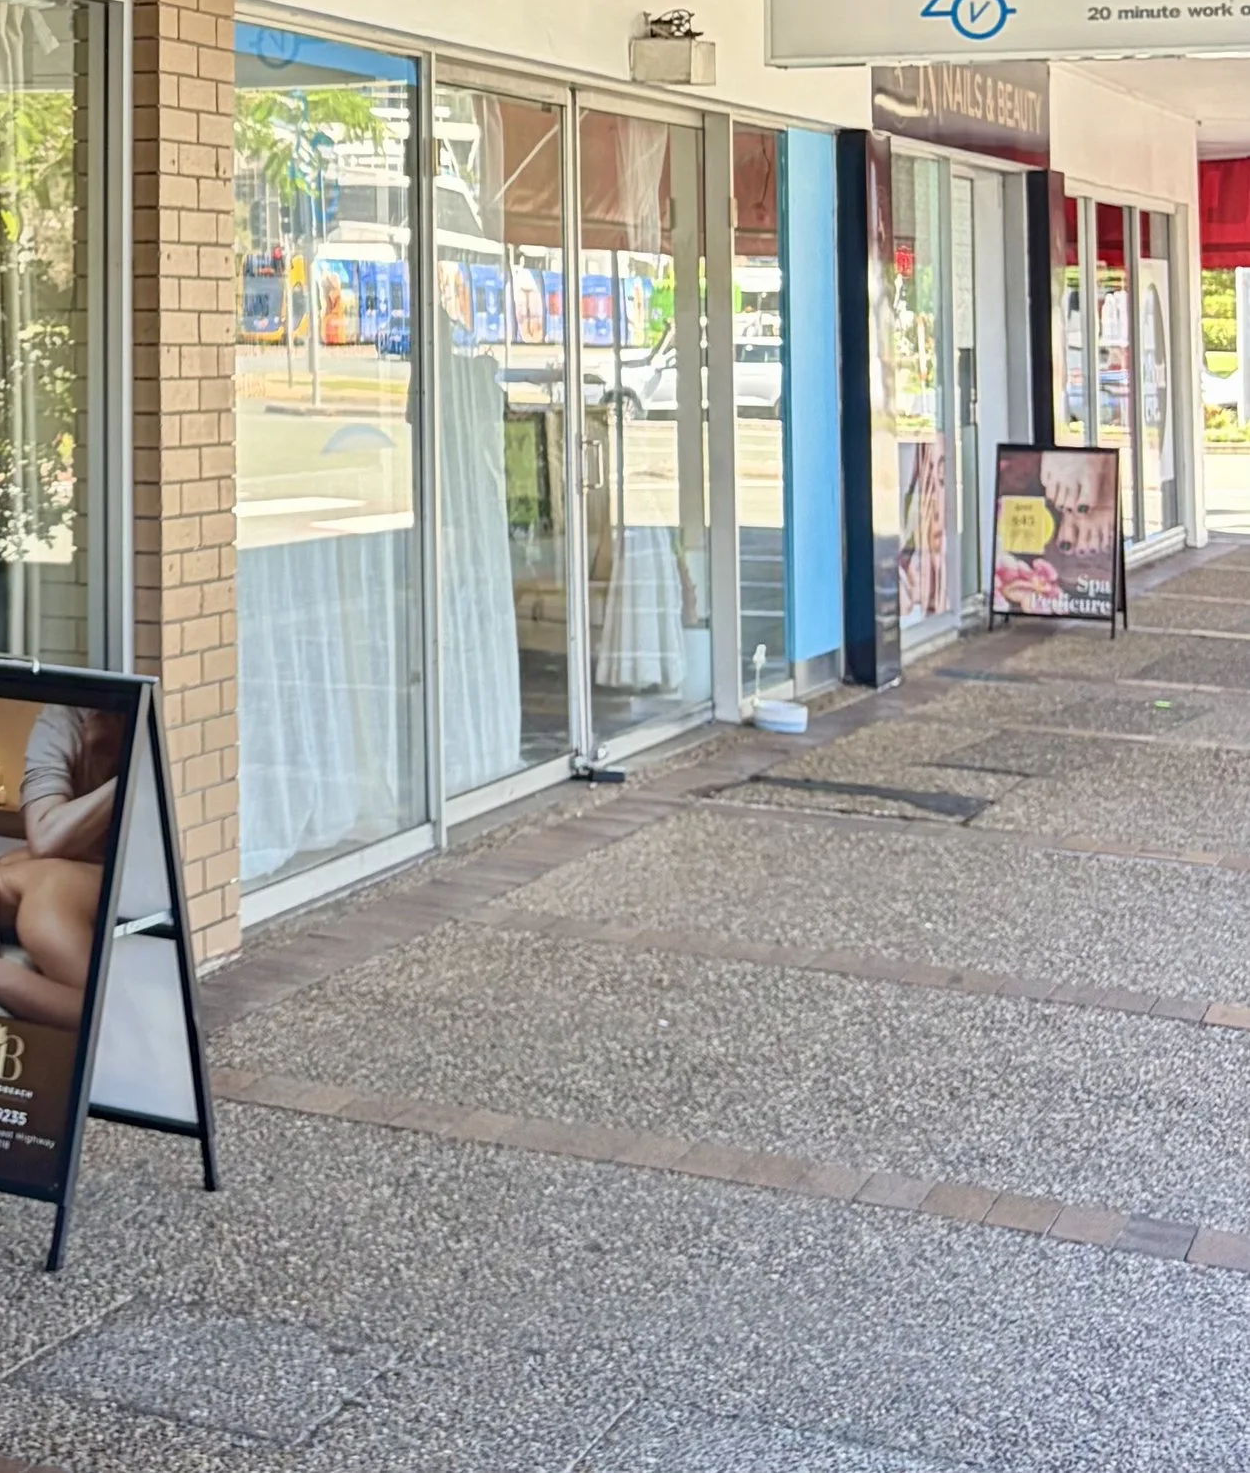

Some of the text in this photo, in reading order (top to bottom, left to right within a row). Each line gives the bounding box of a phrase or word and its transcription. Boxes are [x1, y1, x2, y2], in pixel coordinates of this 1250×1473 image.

[1087, 6, 1112, 21] 20
[1117, 5, 1181, 20] minute
[1187, 2, 1234, 18] work
[942, 63, 983, 120] NAILS
[986, 77, 995, 123] &
[997, 80, 1043, 135] BEAUTY
[1076, 573, 1112, 598] Spa
